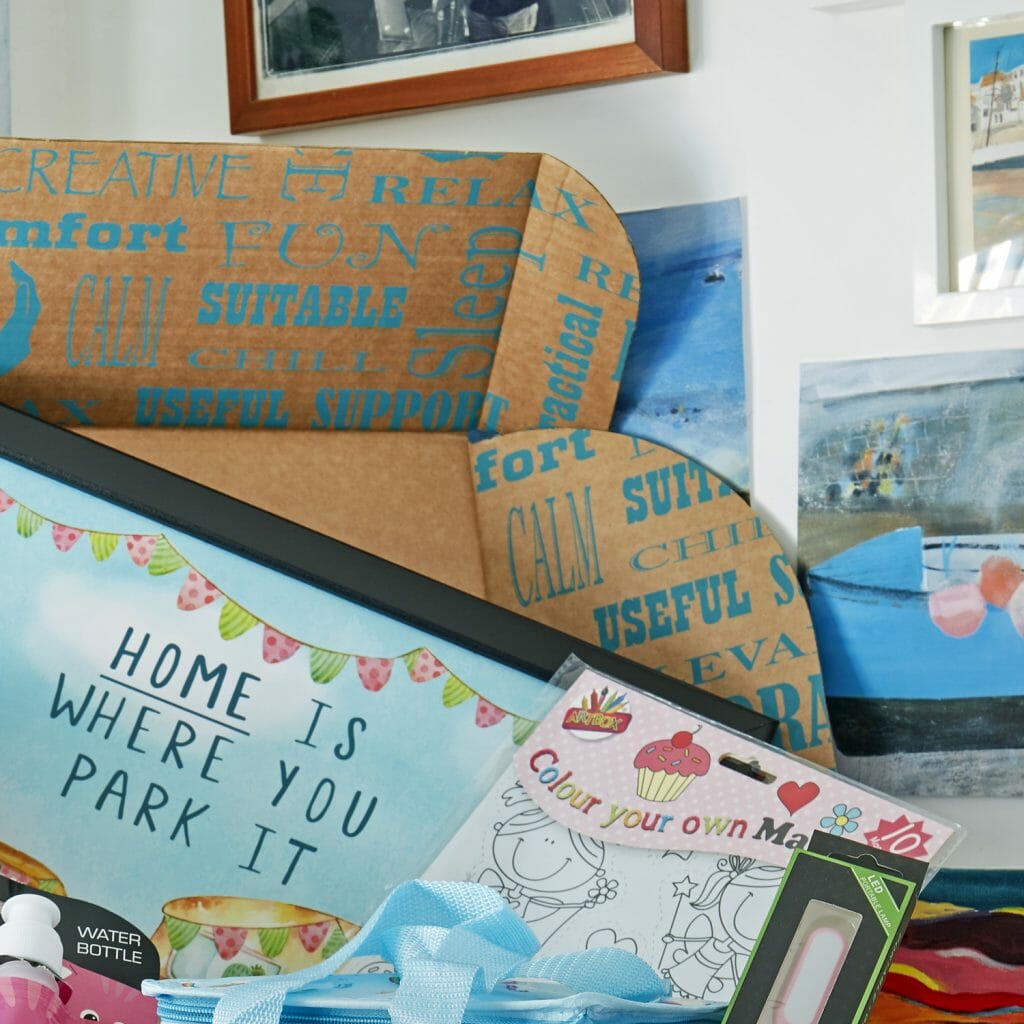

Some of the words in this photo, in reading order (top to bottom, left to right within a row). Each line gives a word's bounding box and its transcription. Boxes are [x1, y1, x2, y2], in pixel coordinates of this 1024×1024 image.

[370, 174, 600, 233] RELAX
[216, 218, 451, 270] FUN
[65, 272, 172, 368] CALM
[197, 282, 408, 329] SUITABLE
[186, 347, 388, 373] CHILL
[134, 387, 290, 430] USEFUL
[311, 388, 509, 432] SUPPORT
[506, 486, 605, 608] CALM
[630, 516, 775, 572] CHIL
[594, 568, 752, 651] USEFUL
[110, 626, 261, 721] HOME
[294, 698, 367, 760] IS
[49, 672, 234, 784] WHERE
[271, 760, 378, 838] YOU
[60, 753, 211, 848] PARK
[238, 823, 319, 886] IT
[529, 748, 603, 816] Colour
[599, 804, 674, 834] your
[682, 814, 747, 839] own
[867, 874, 884, 894] LED
[77, 925, 142, 947] WATER
[77, 942, 143, 965] BOTTLE
